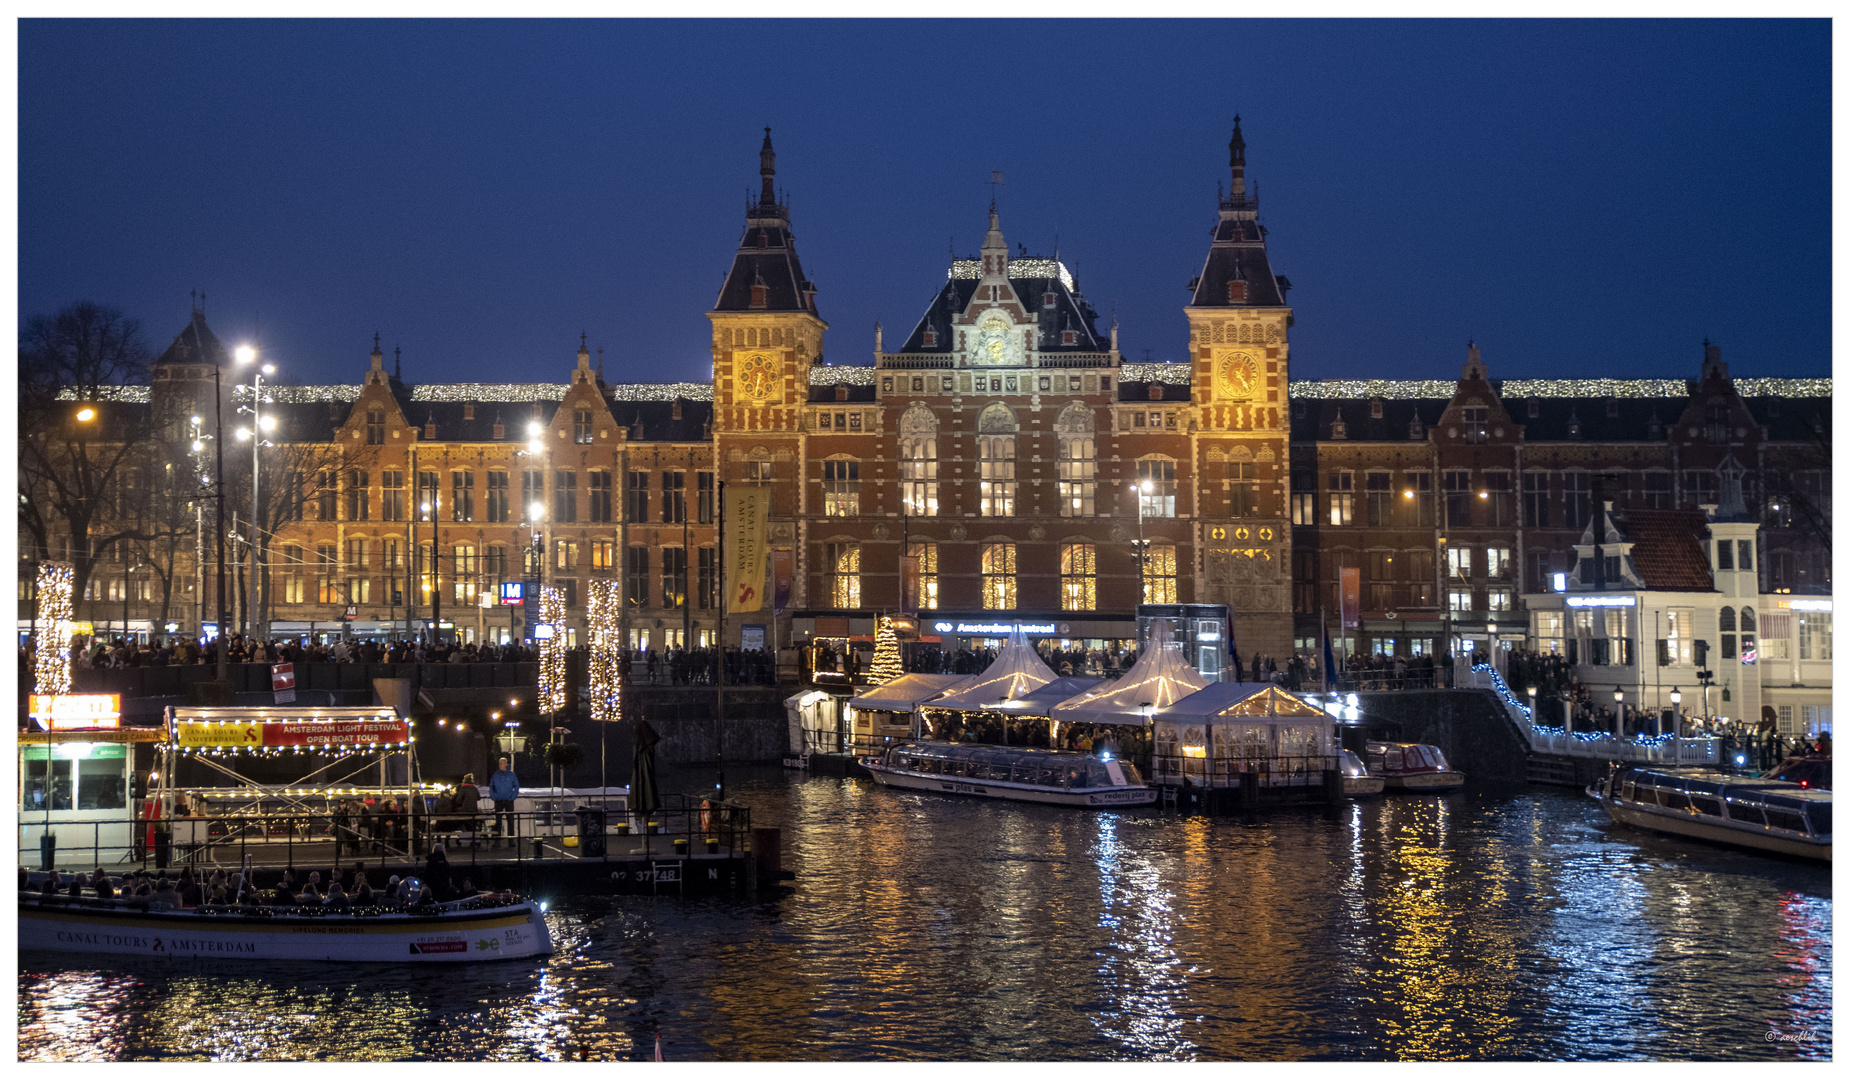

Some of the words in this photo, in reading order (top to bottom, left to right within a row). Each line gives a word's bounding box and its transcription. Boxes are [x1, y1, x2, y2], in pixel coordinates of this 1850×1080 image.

[747, 495, 755, 530] CANAL
[738, 499, 746, 571] AMSTERDAM
[747, 539, 755, 574] TOURS
[506, 583, 521, 598] M
[346, 606, 357, 615] M
[957, 623, 1012, 633] Amsterdam
[283, 725, 335, 733] AMSTERDAM
[363, 723, 401, 732] FESTIVAL
[306, 735, 330, 743] OPEN
[331, 735, 353, 743] BOAT
[354, 734, 380, 742] TOUR
[955, 782, 972, 793] plas
[1104, 791, 1130, 801] rederij
[1131, 791, 1145, 801] plas
[708, 868, 718, 879] N
[57, 931, 101, 945] CANAL
[104, 934, 148, 948] TOURS
[170, 939, 256, 953] AMSTERDAM
